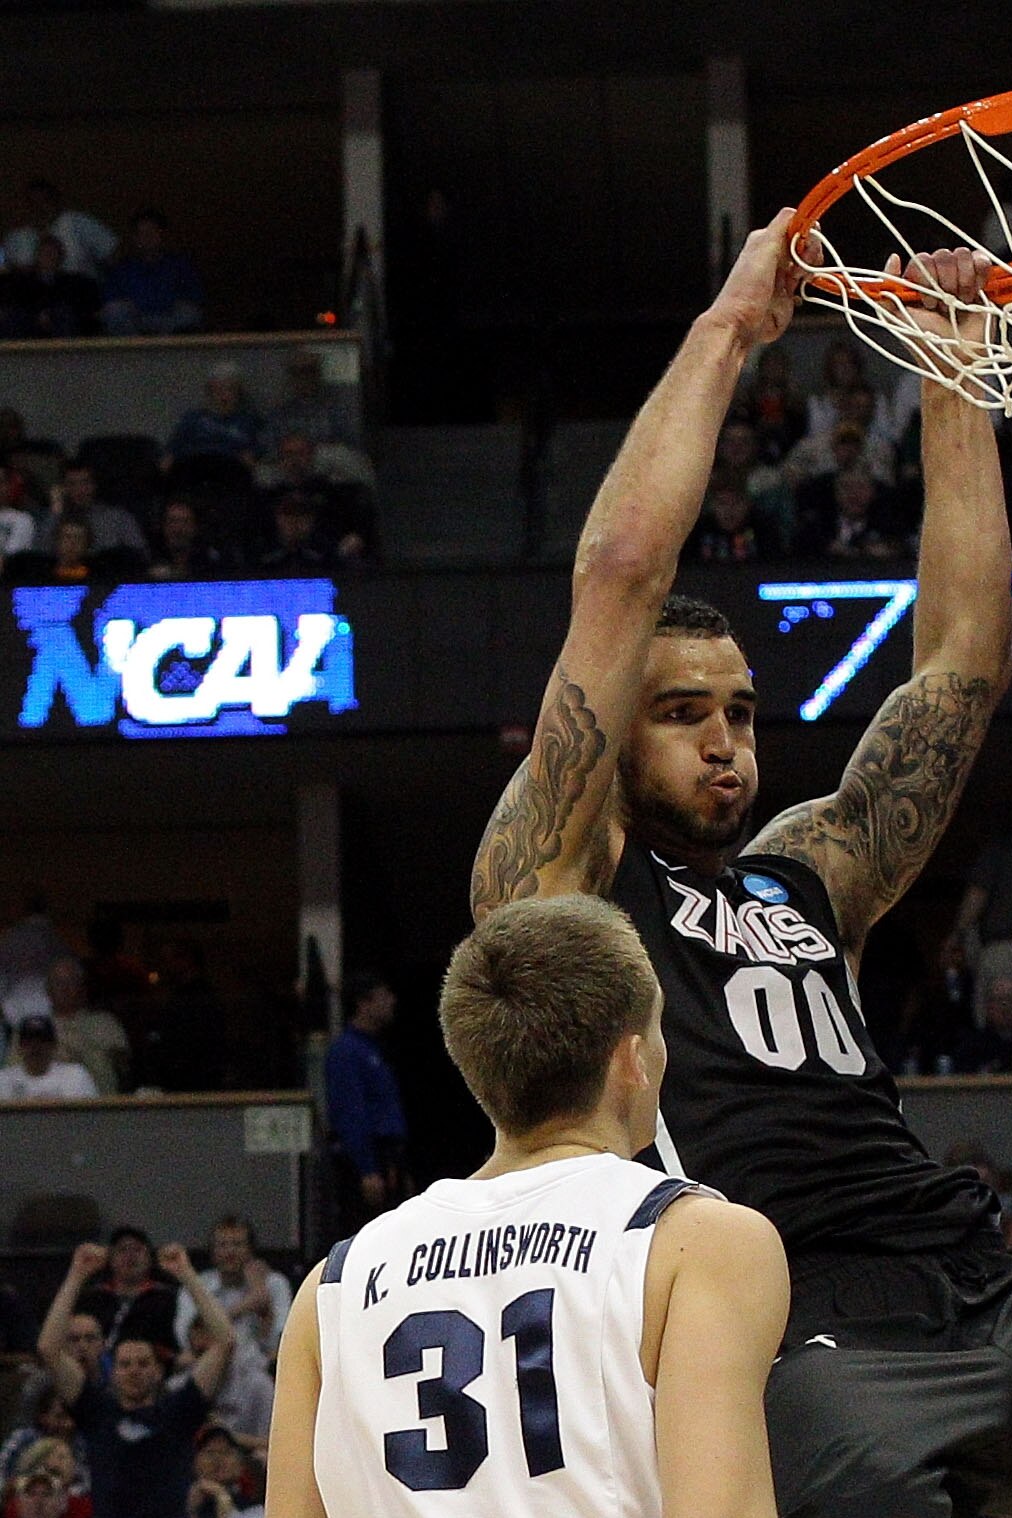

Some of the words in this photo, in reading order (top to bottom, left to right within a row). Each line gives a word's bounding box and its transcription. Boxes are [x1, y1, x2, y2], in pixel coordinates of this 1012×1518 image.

[11, 580, 361, 739] NCAA
[667, 875, 836, 966] ZAGS
[724, 965, 867, 1077] 00
[363, 1262, 389, 1310] K.
[407, 1222, 597, 1287] COLLINSWORTH
[383, 1287, 565, 1491] 31
